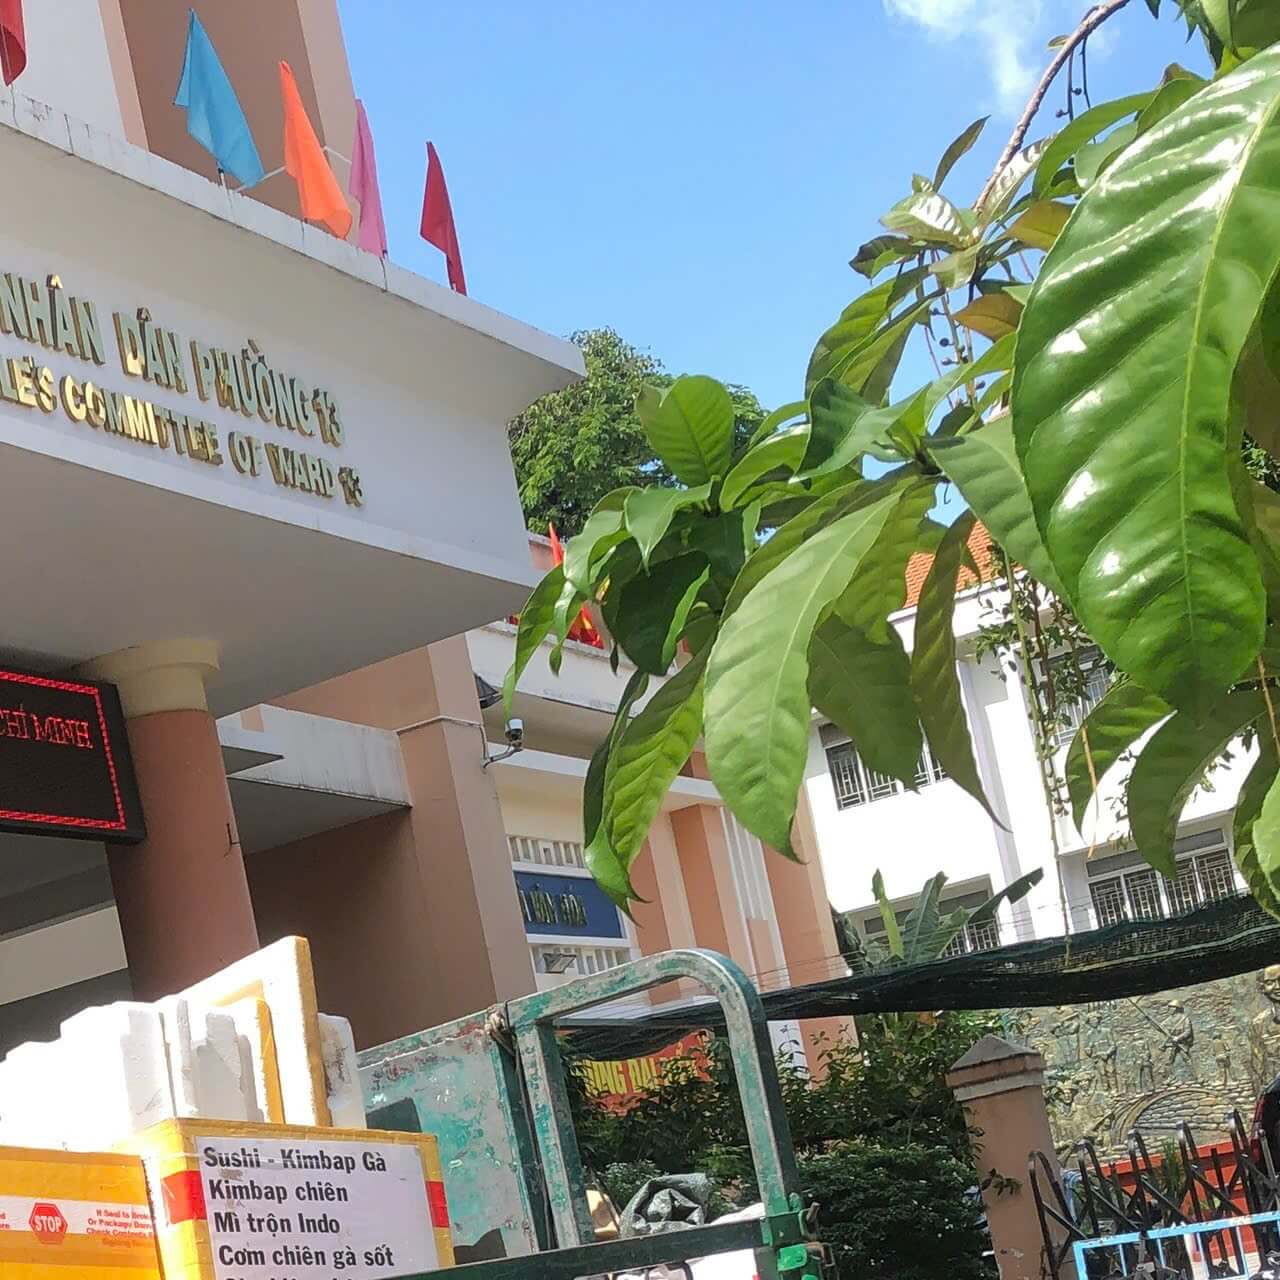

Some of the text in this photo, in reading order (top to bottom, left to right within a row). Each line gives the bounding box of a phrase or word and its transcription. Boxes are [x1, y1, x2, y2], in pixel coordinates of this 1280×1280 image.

[112, 305, 189, 394] DÂN
[60, 375, 223, 466] COMMITTEE
[228, 431, 261, 477] OF
[264, 442, 336, 499] WARD
[31, 713, 94, 749] MINH
[203, 1147, 261, 1169] Sushi
[280, 1149, 356, 1174] Kimbap
[363, 1151, 386, 1172] Gà
[208, 1179, 348, 1204] Kimbap chiên
[34, 1215, 62, 1233] STOP
[214, 1211, 340, 1237] Mì trộn Indo
[219, 1243, 394, 1269] Cơm chiên gà sốt
